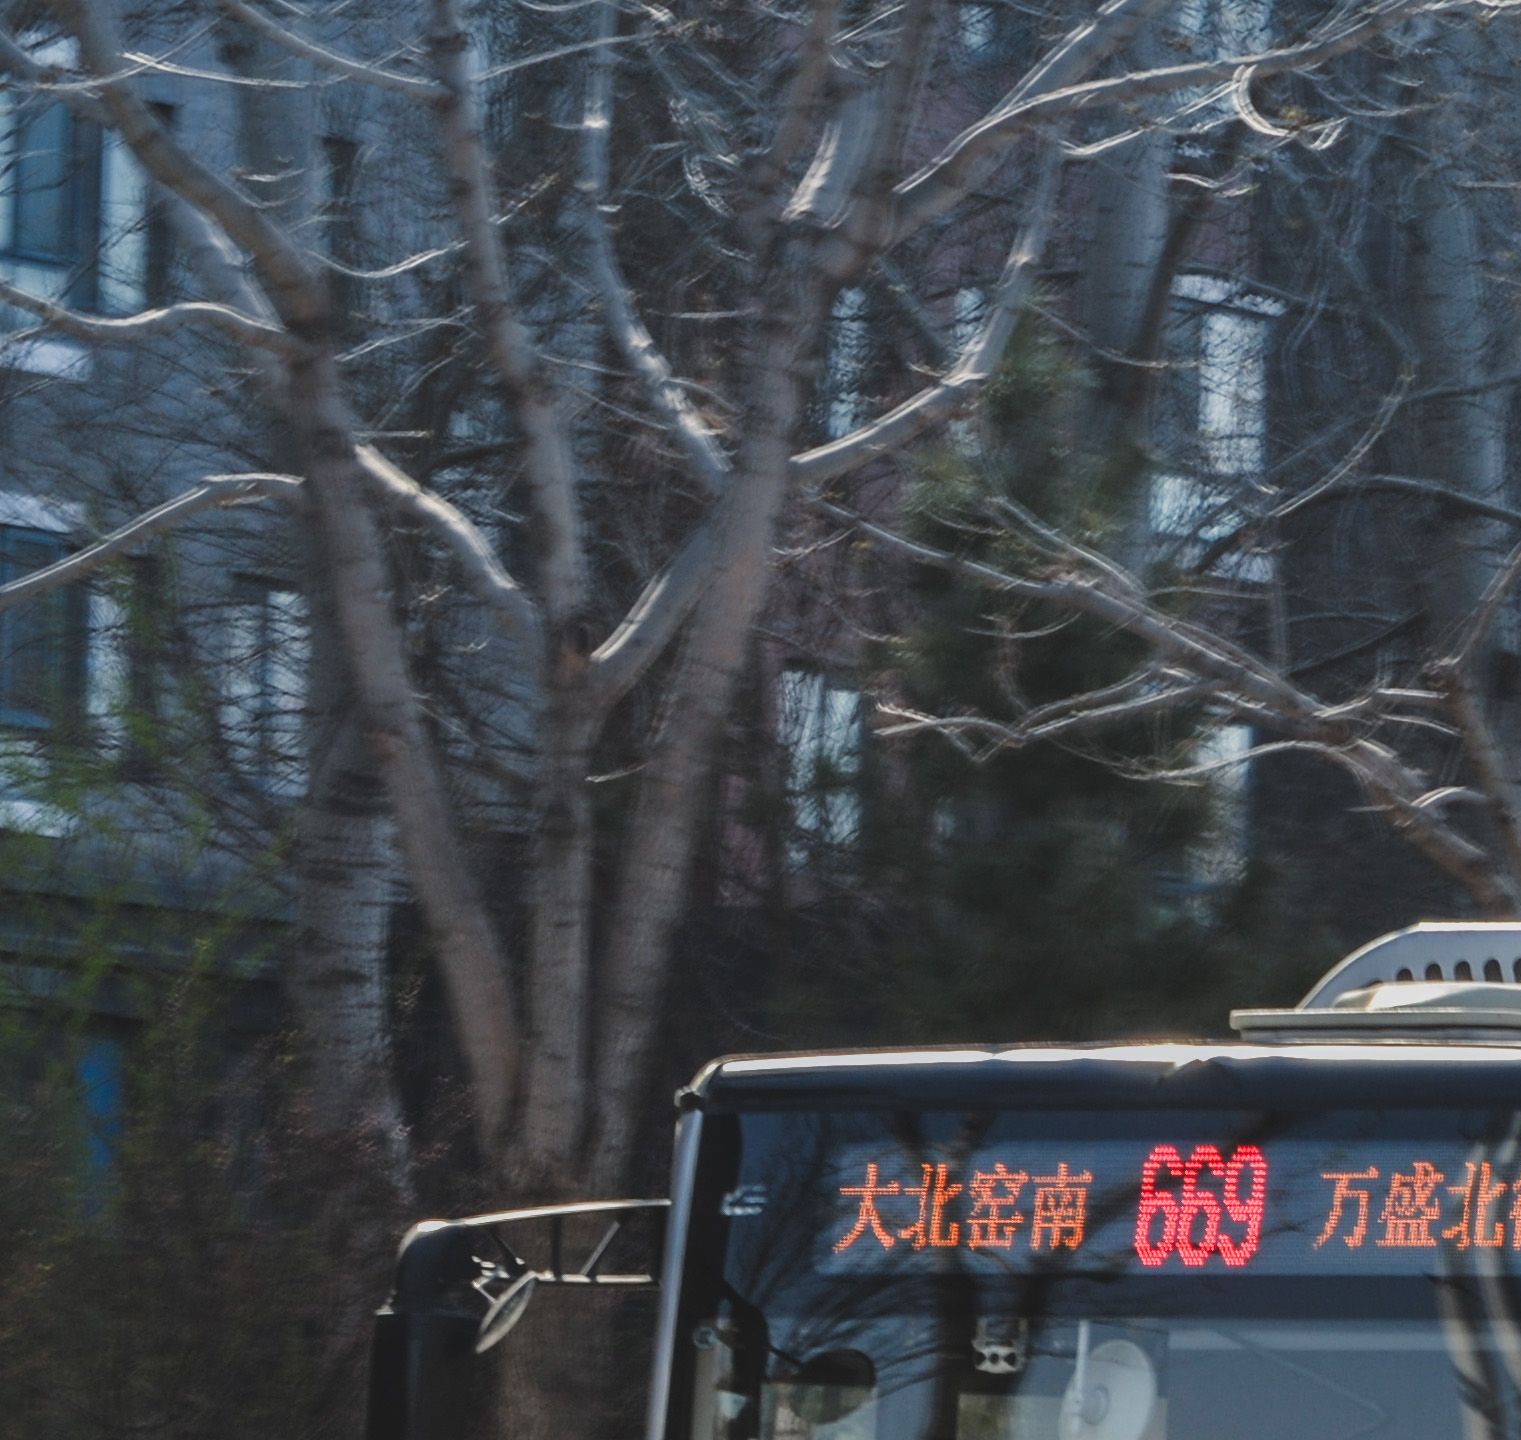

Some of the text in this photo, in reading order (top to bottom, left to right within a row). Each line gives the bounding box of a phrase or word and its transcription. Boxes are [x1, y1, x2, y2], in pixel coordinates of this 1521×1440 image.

[832, 1162, 1094, 1254] 大北窑南
[1134, 1144, 1269, 1267] 669
